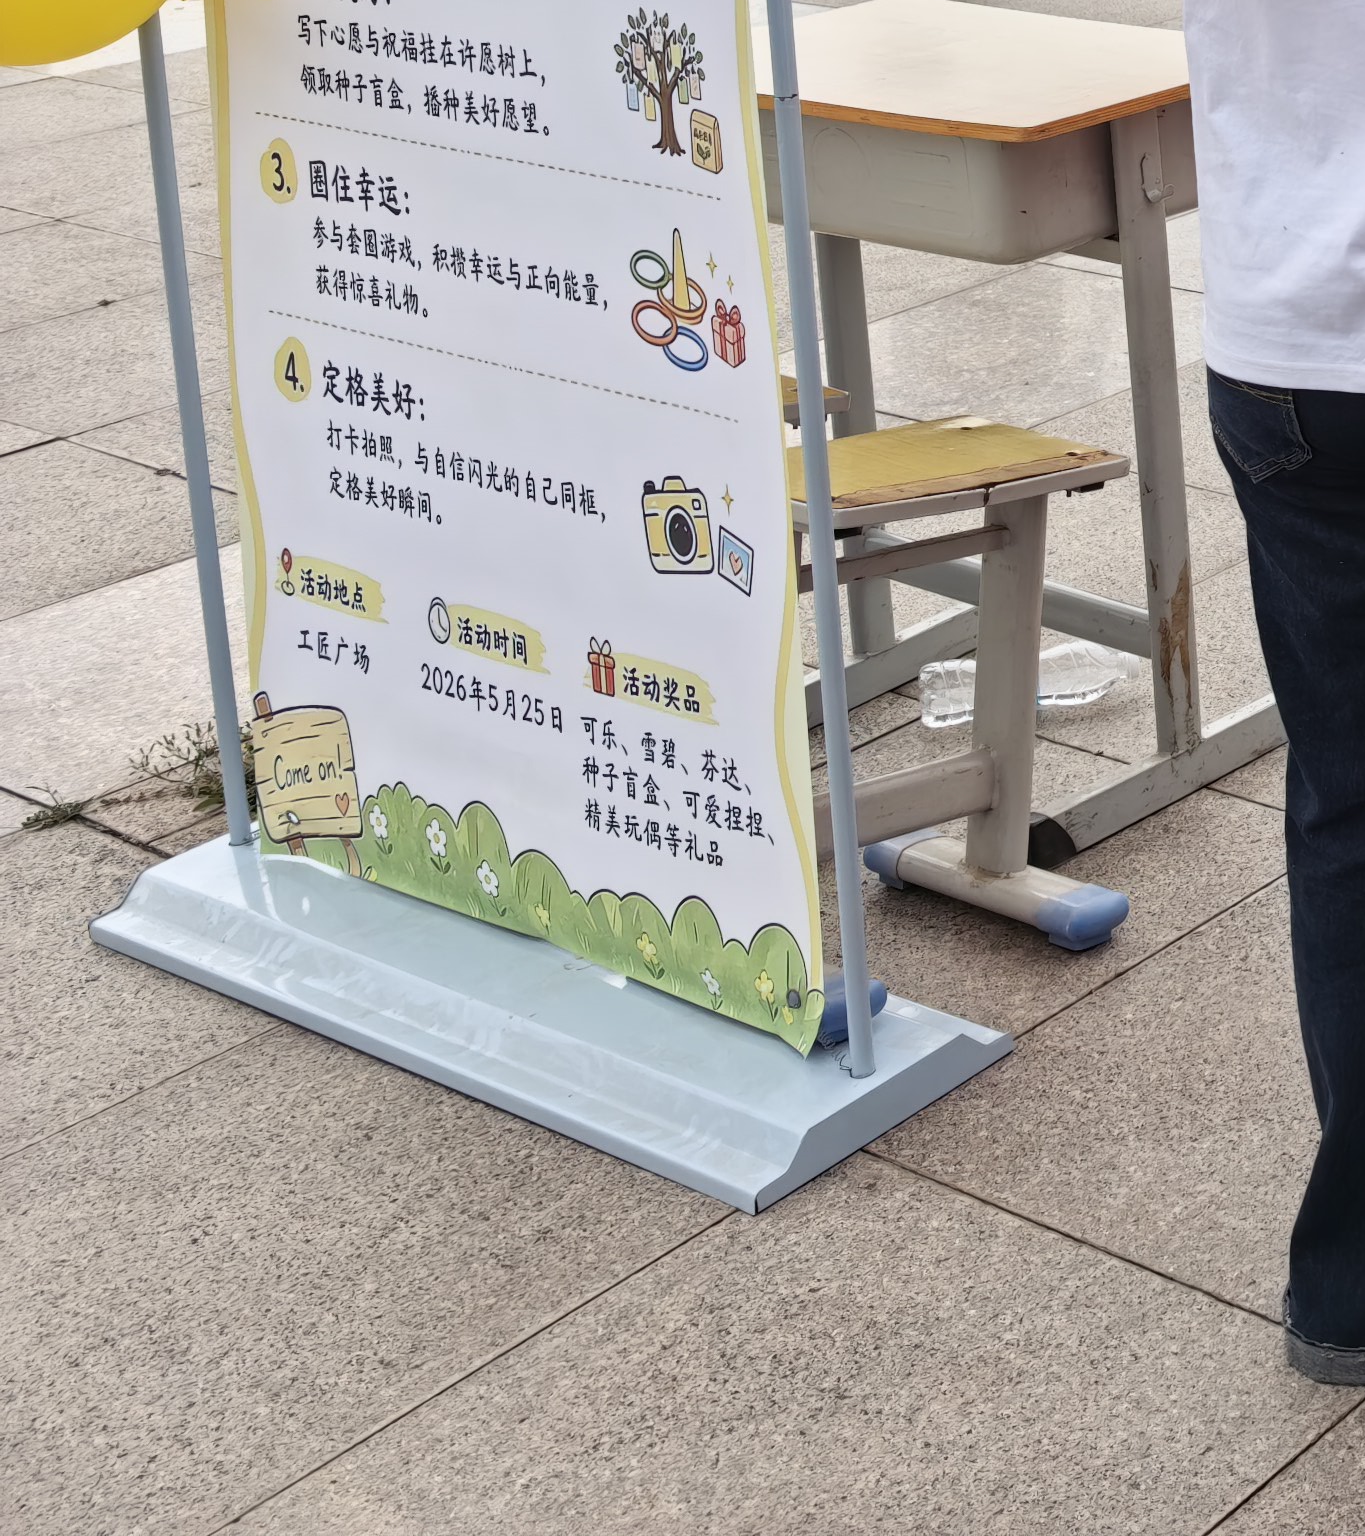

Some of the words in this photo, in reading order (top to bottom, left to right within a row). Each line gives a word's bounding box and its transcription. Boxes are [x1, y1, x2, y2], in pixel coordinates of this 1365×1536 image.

[271, 151, 291, 195] 3.
[308, 160, 411, 216] 圈住幸运：
[284, 350, 305, 393] 4.
[322, 359, 426, 422] 定格美好：
[299, 568, 367, 613] 活动地点
[297, 629, 371, 675] 工匠广场
[456, 616, 529, 666] 活动时间
[420, 662, 564, 734] 2026年5月25日
[622, 665, 701, 714] 活动奖品
[273, 754, 313, 791] Come
[317, 743, 344, 781] on!
[584, 797, 724, 867] 精美玩偶等礼品
